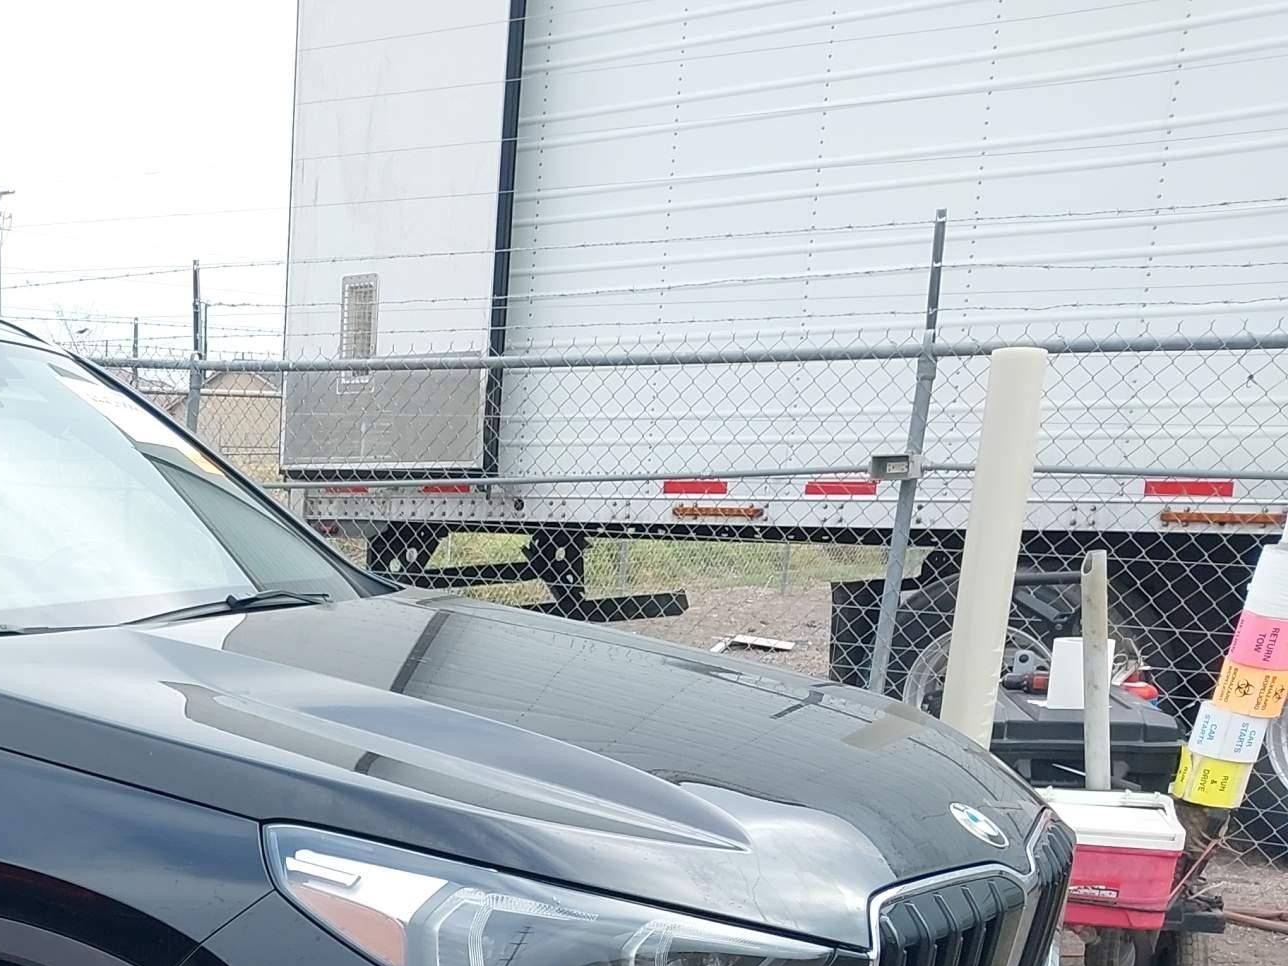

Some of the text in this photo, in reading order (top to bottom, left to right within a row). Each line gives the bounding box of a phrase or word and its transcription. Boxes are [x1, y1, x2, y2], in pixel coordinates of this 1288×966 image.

[1254, 633, 1266, 653] TOW
[1262, 627, 1280, 662] RETURN
[1196, 713, 1211, 745] STARTS
[1206, 723, 1217, 741] CAR
[1233, 721, 1249, 754] STARTS
[1246, 729, 1256, 747] CAR
[1197, 768, 1210, 793] DRIVE
[1219, 775, 1229, 792] RUN
